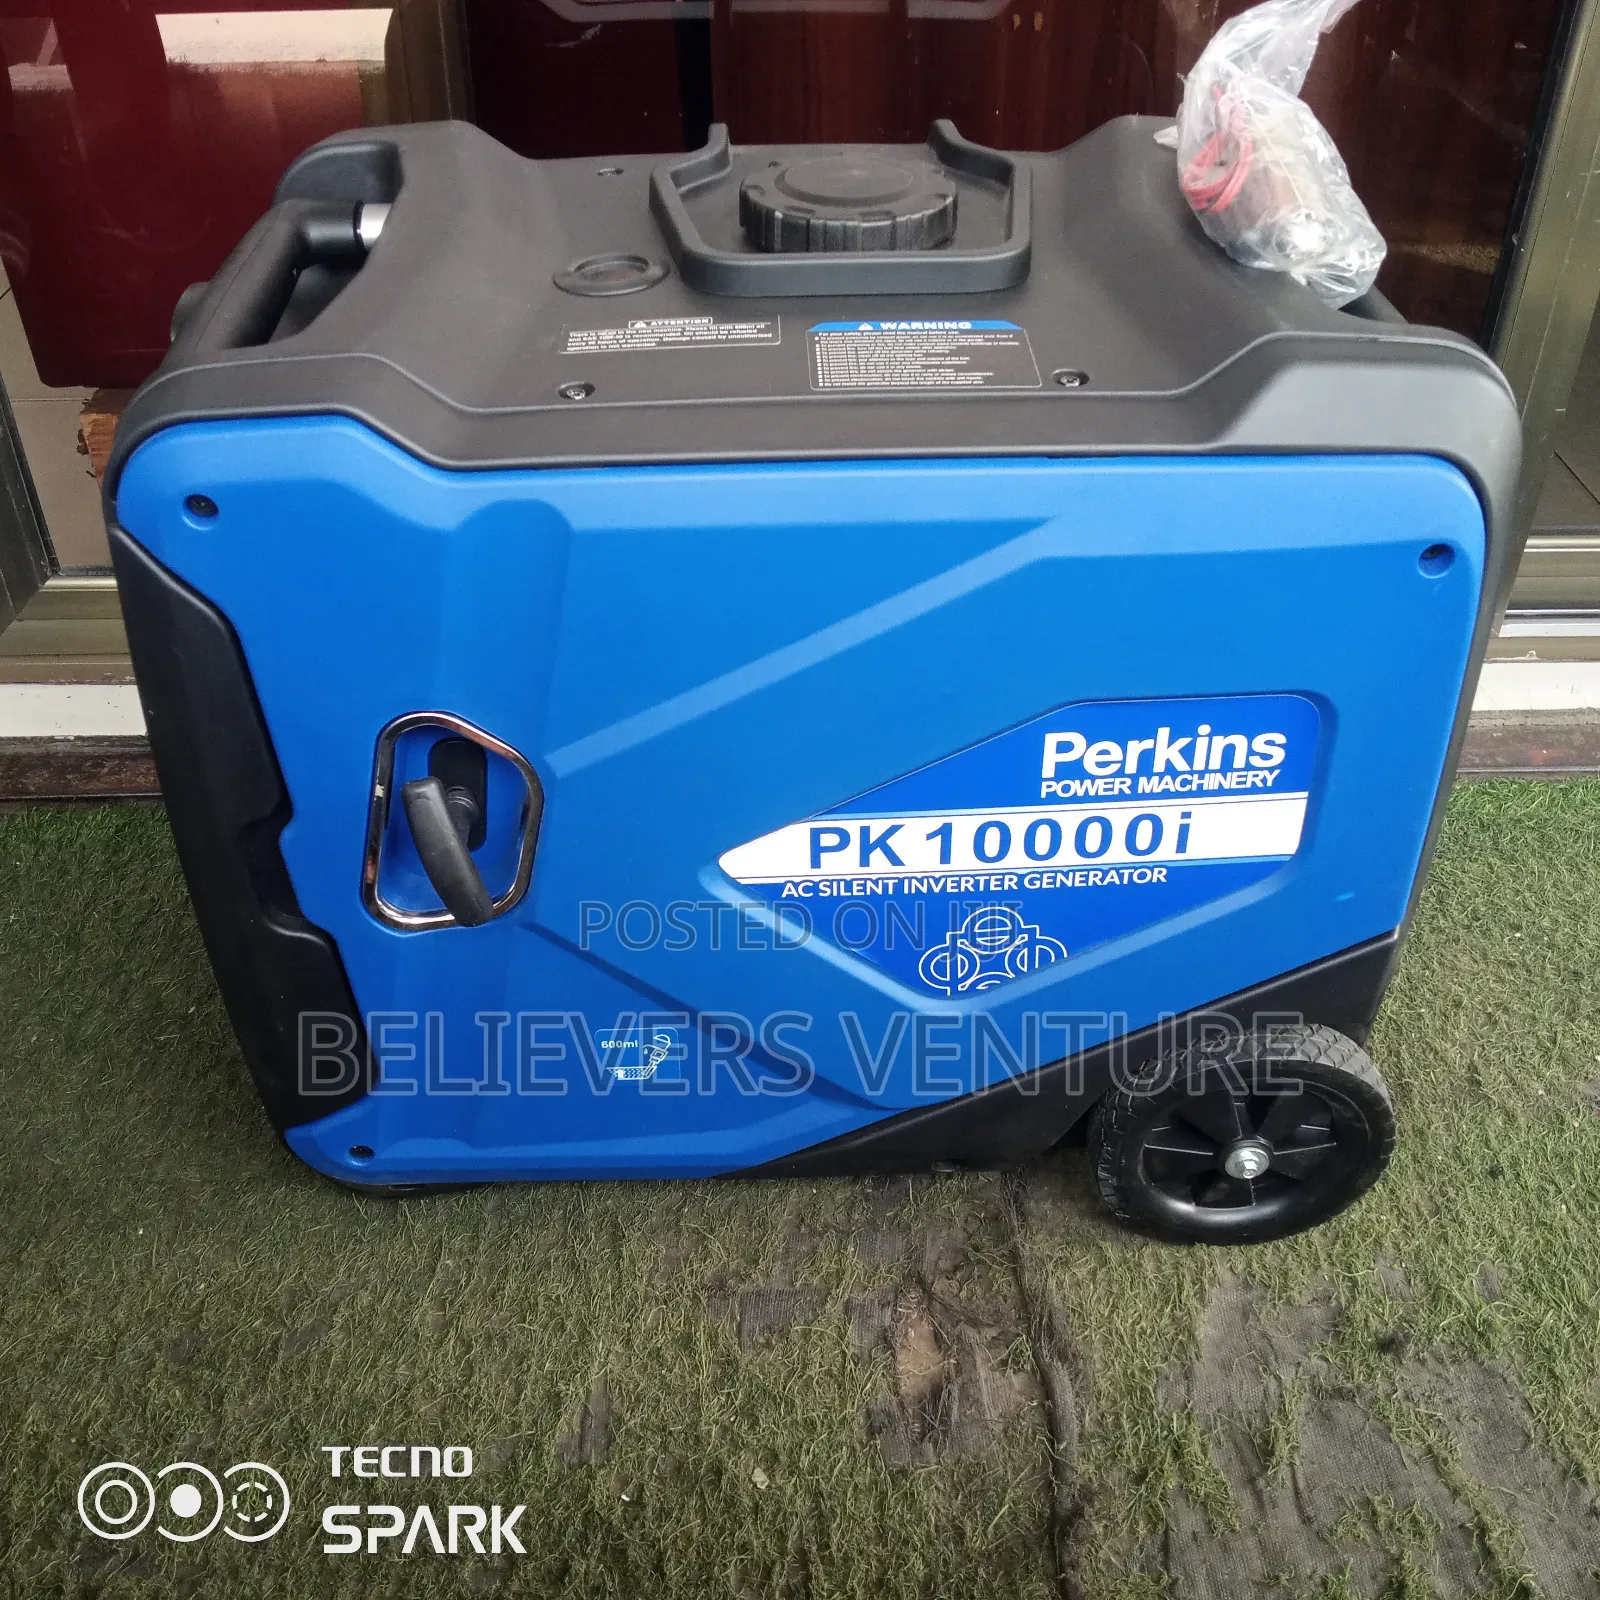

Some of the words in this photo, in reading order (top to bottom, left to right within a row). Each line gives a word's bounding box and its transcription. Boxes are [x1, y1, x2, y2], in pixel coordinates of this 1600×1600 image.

[880, 321, 972, 330] WARNING
[1041, 724, 1287, 779] Perkins
[1040, 775, 1134, 799] POWER
[1137, 769, 1282, 794] MACHINERY
[781, 879, 816, 899] AC
[818, 876, 900, 898] SILENT
[902, 872, 1020, 894] INVERTER
[1022, 866, 1168, 891] GENERATOR
[600, 1040, 638, 1049] 600ml
